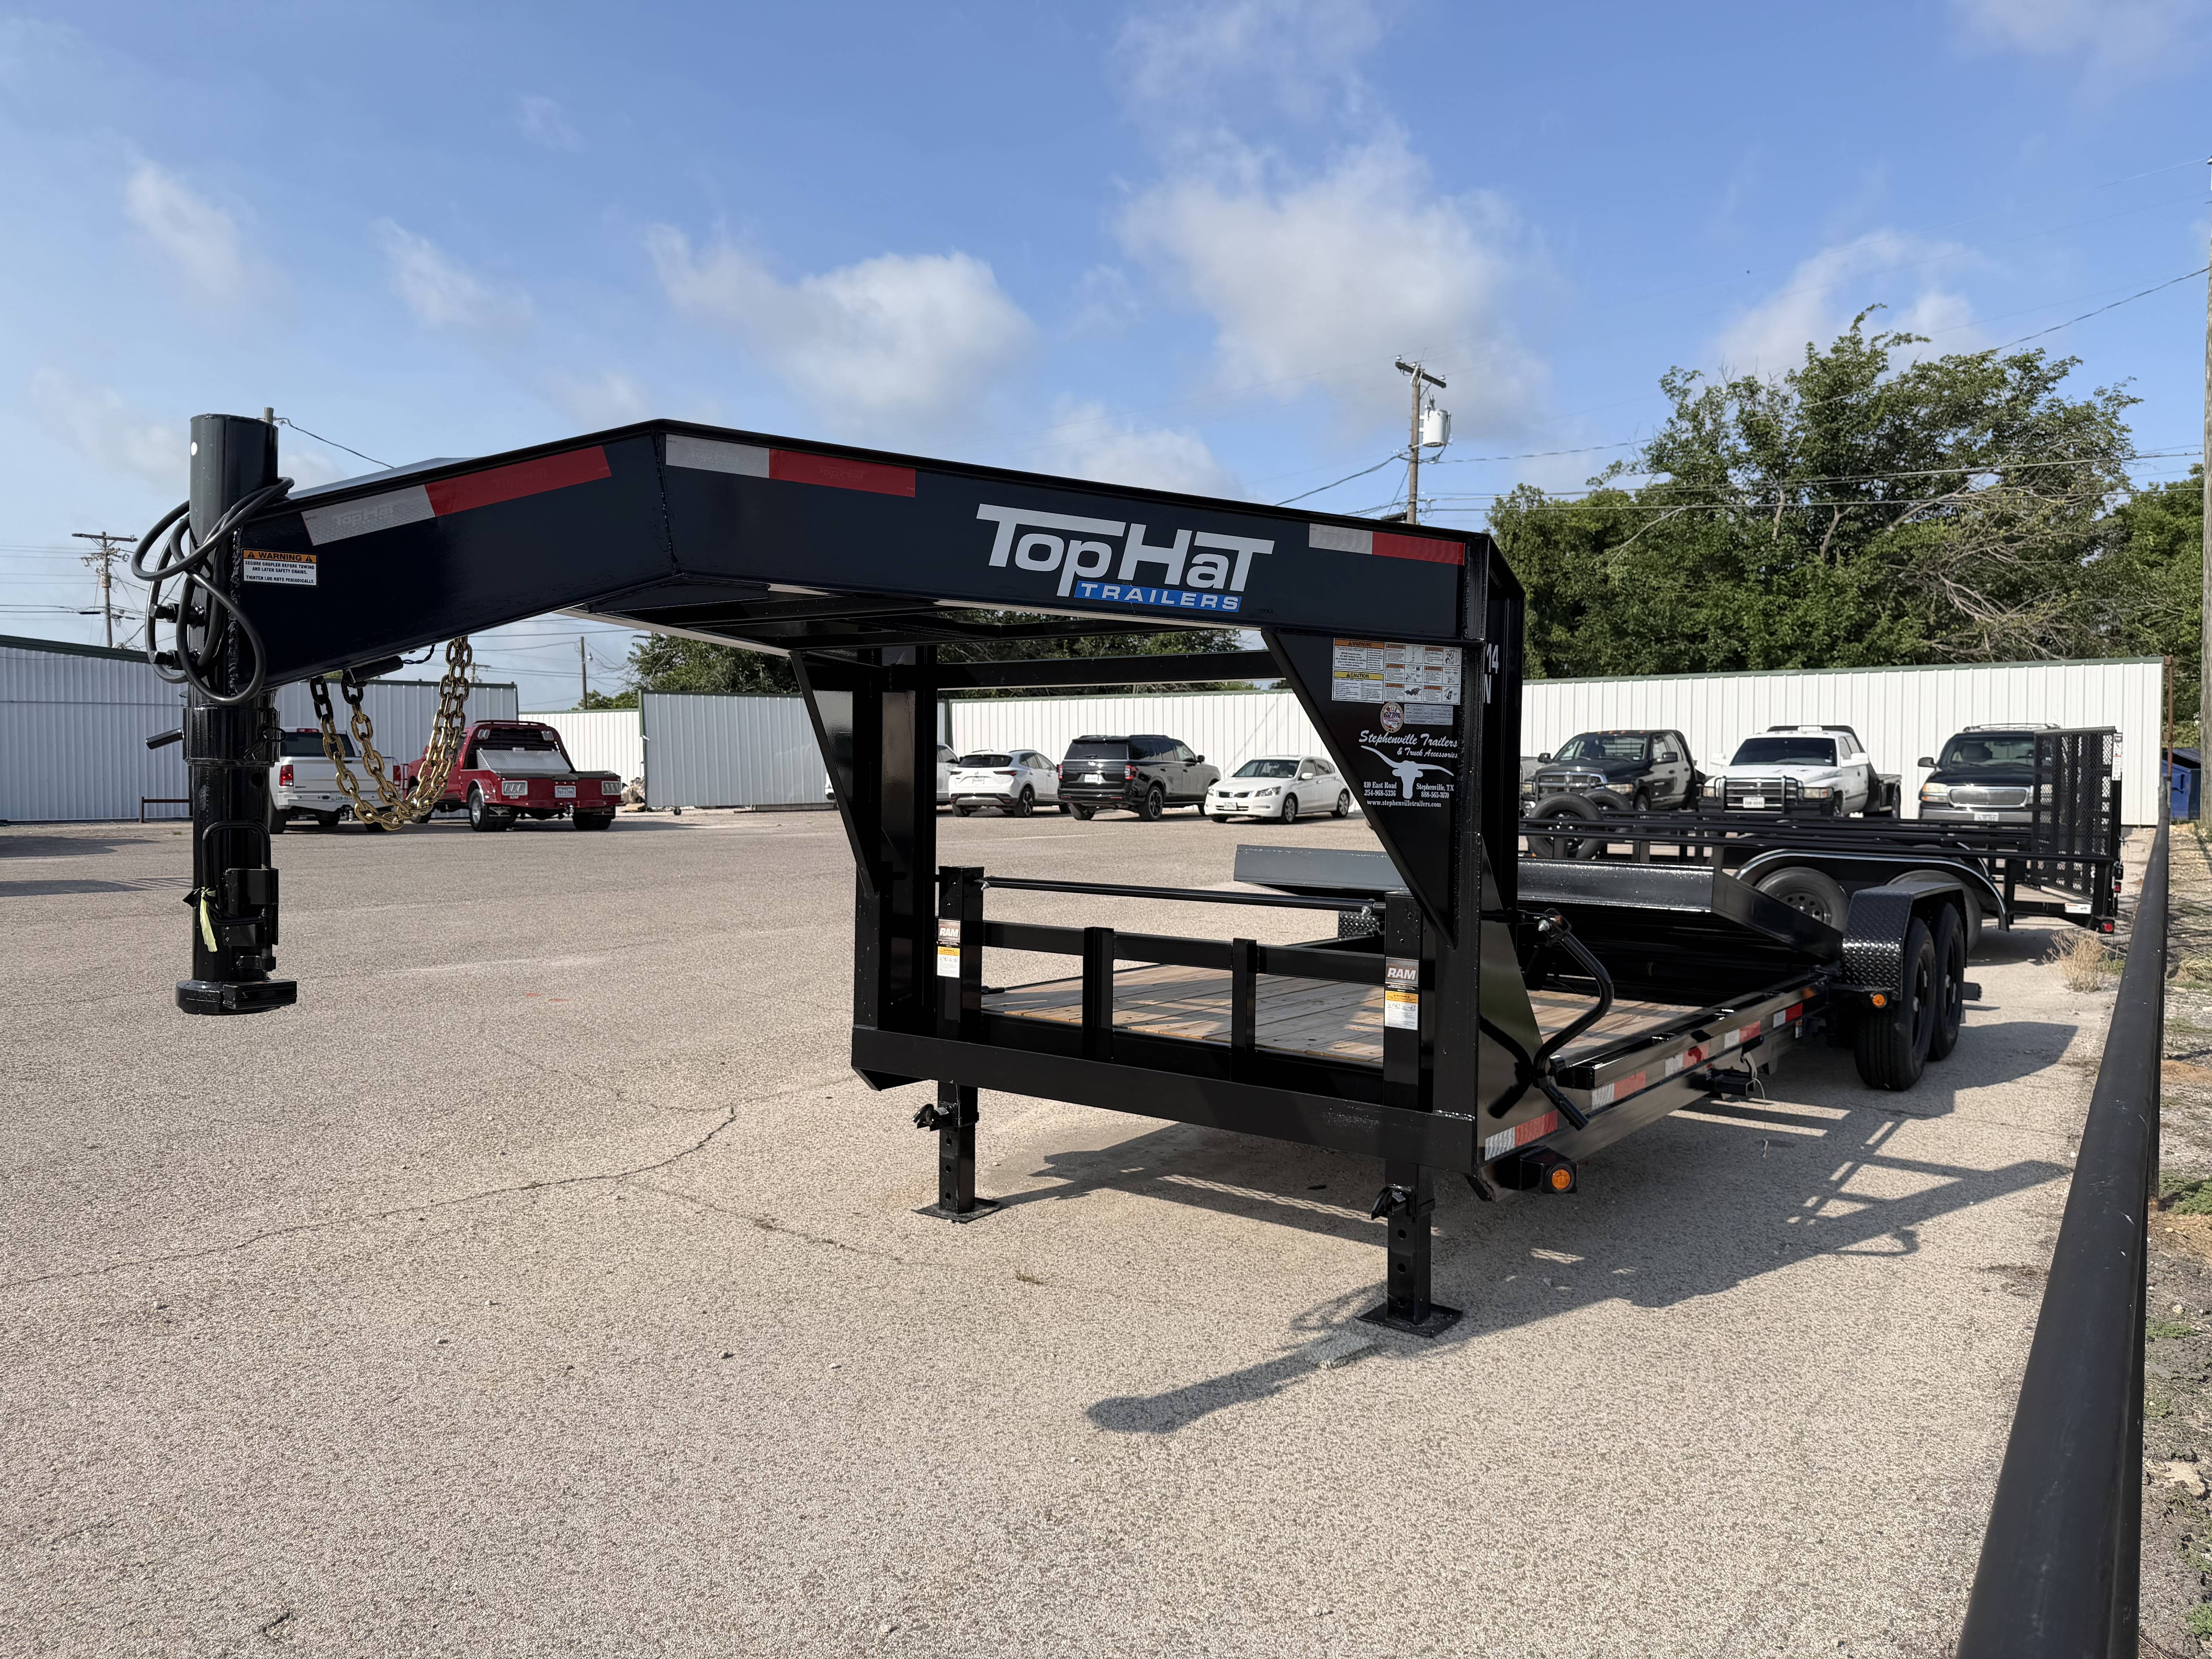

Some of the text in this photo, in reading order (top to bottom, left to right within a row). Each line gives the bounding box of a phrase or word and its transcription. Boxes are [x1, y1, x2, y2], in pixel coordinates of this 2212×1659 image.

[258, 552, 302, 561] WARNING
[1080, 582, 1238, 609] TRAILERS
[1486, 643, 1499, 674] 14
[1358, 730, 1458, 748] Stephenville Trailers
[1397, 747, 1458, 758] & Truck Accessories
[939, 927, 959, 938] RAM
[1387, 967, 1416, 980] RAM
